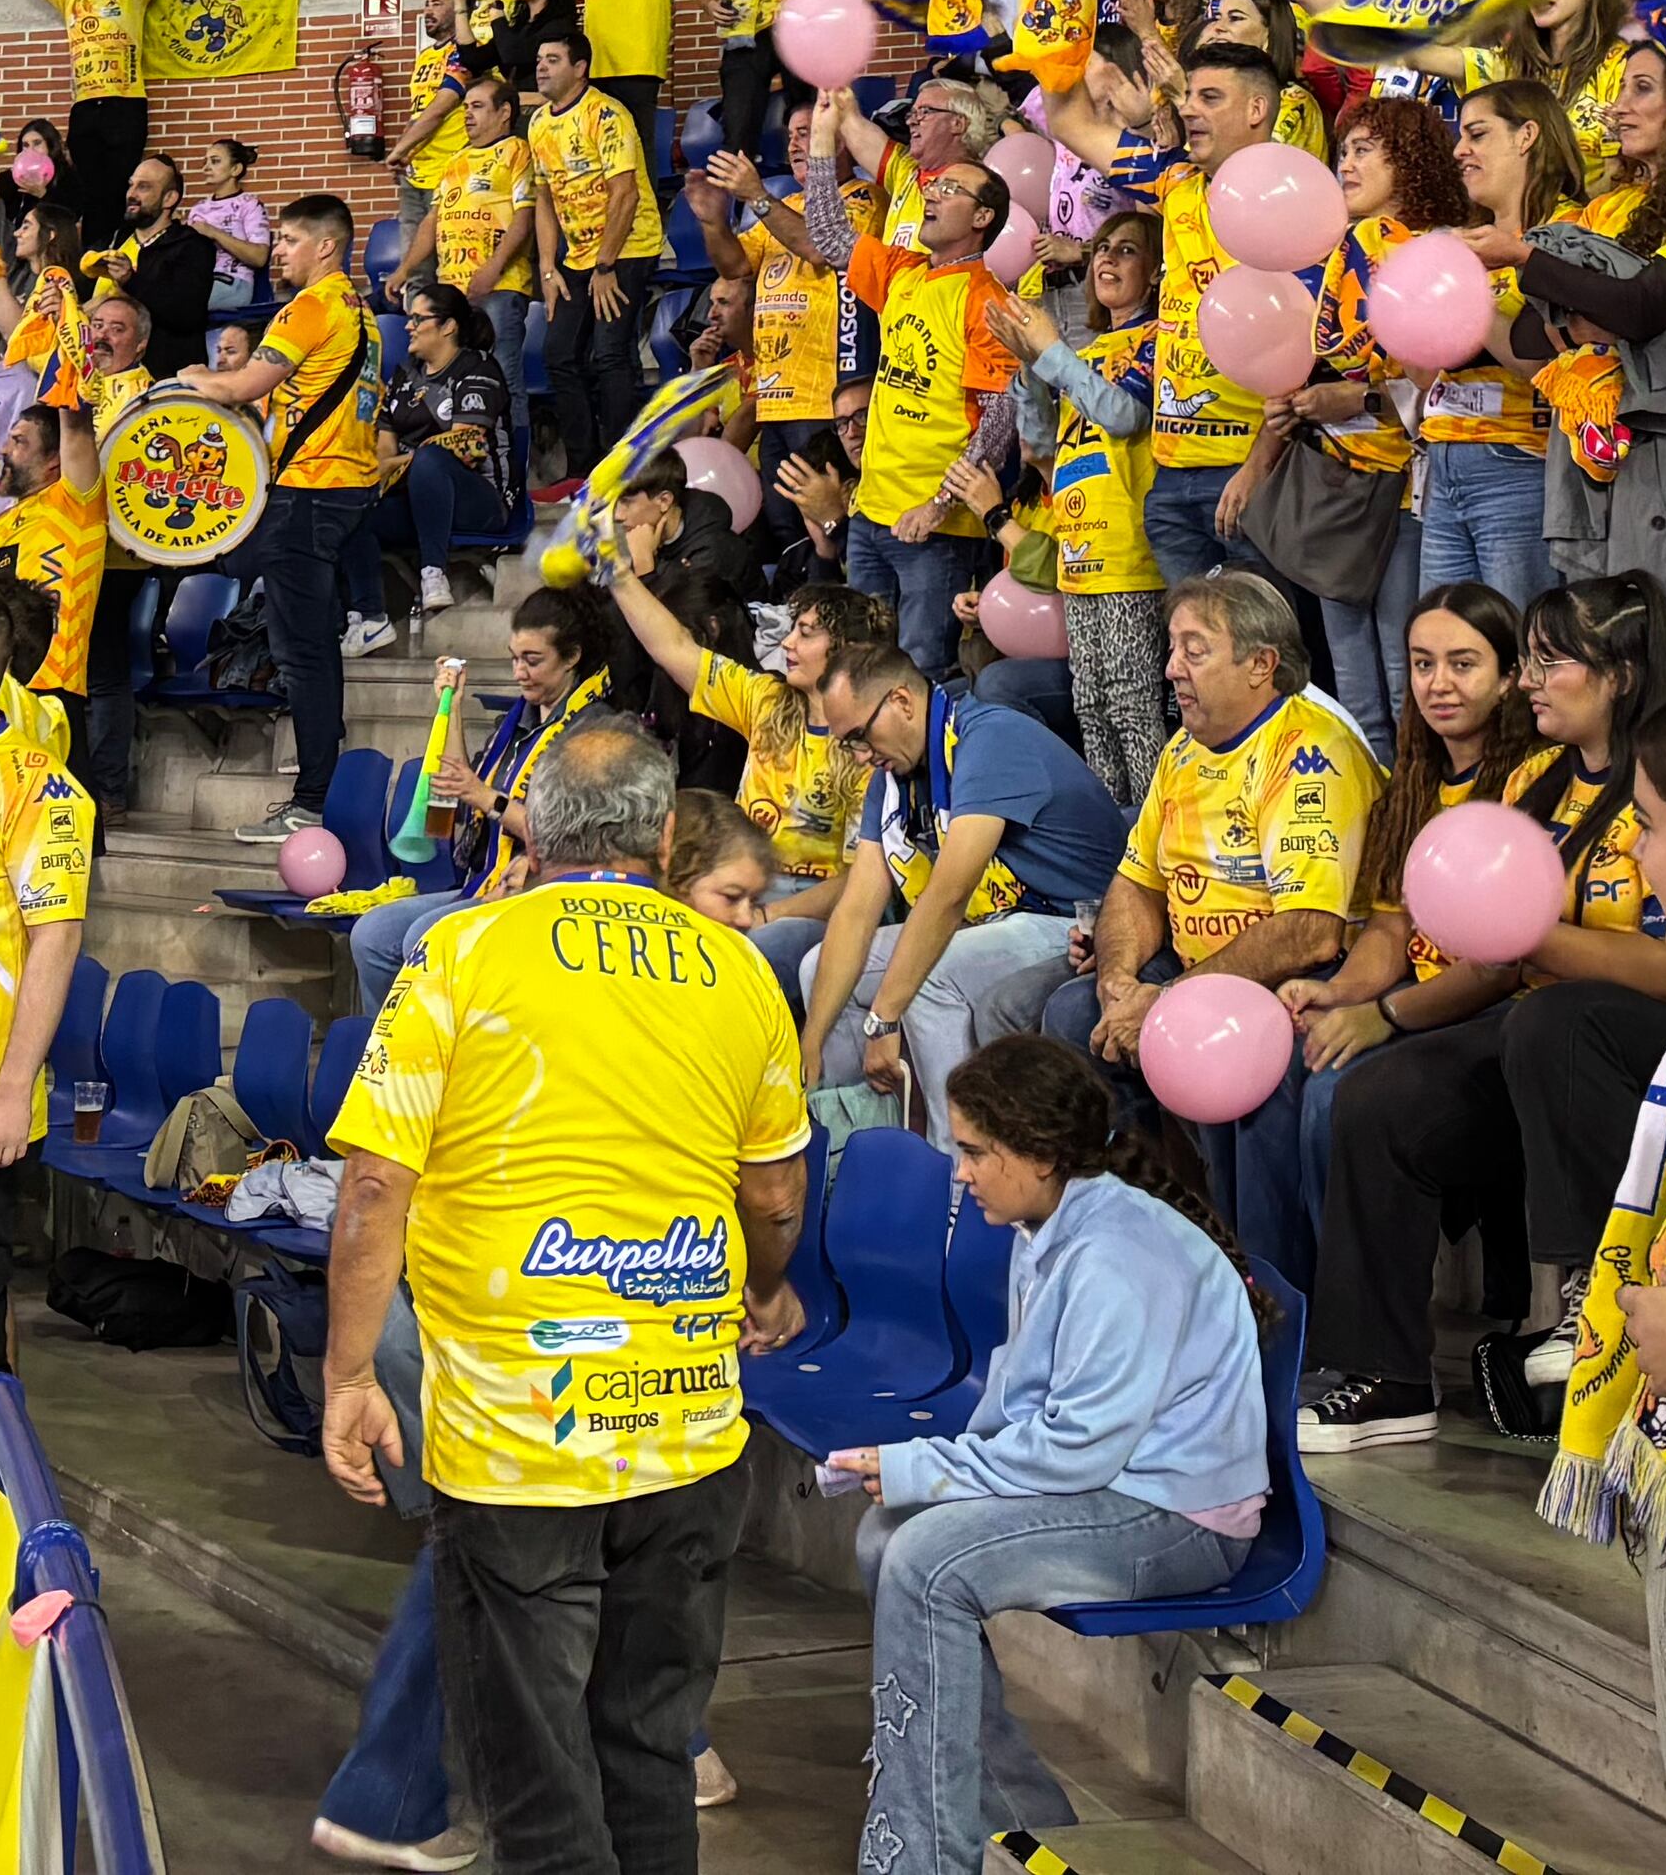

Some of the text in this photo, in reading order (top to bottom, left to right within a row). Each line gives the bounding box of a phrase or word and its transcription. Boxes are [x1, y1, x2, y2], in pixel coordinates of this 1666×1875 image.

[130, 416, 172, 444] PEÑA
[1155, 418, 1250, 437] MICHELIN
[115, 486, 237, 547] VILLA DE ARANDA
[552, 917, 719, 987] CERES
[529, 1221, 724, 1286] Burpellet
[585, 1357, 730, 1409] cajarural
[589, 1411, 659, 1434] Burgos
